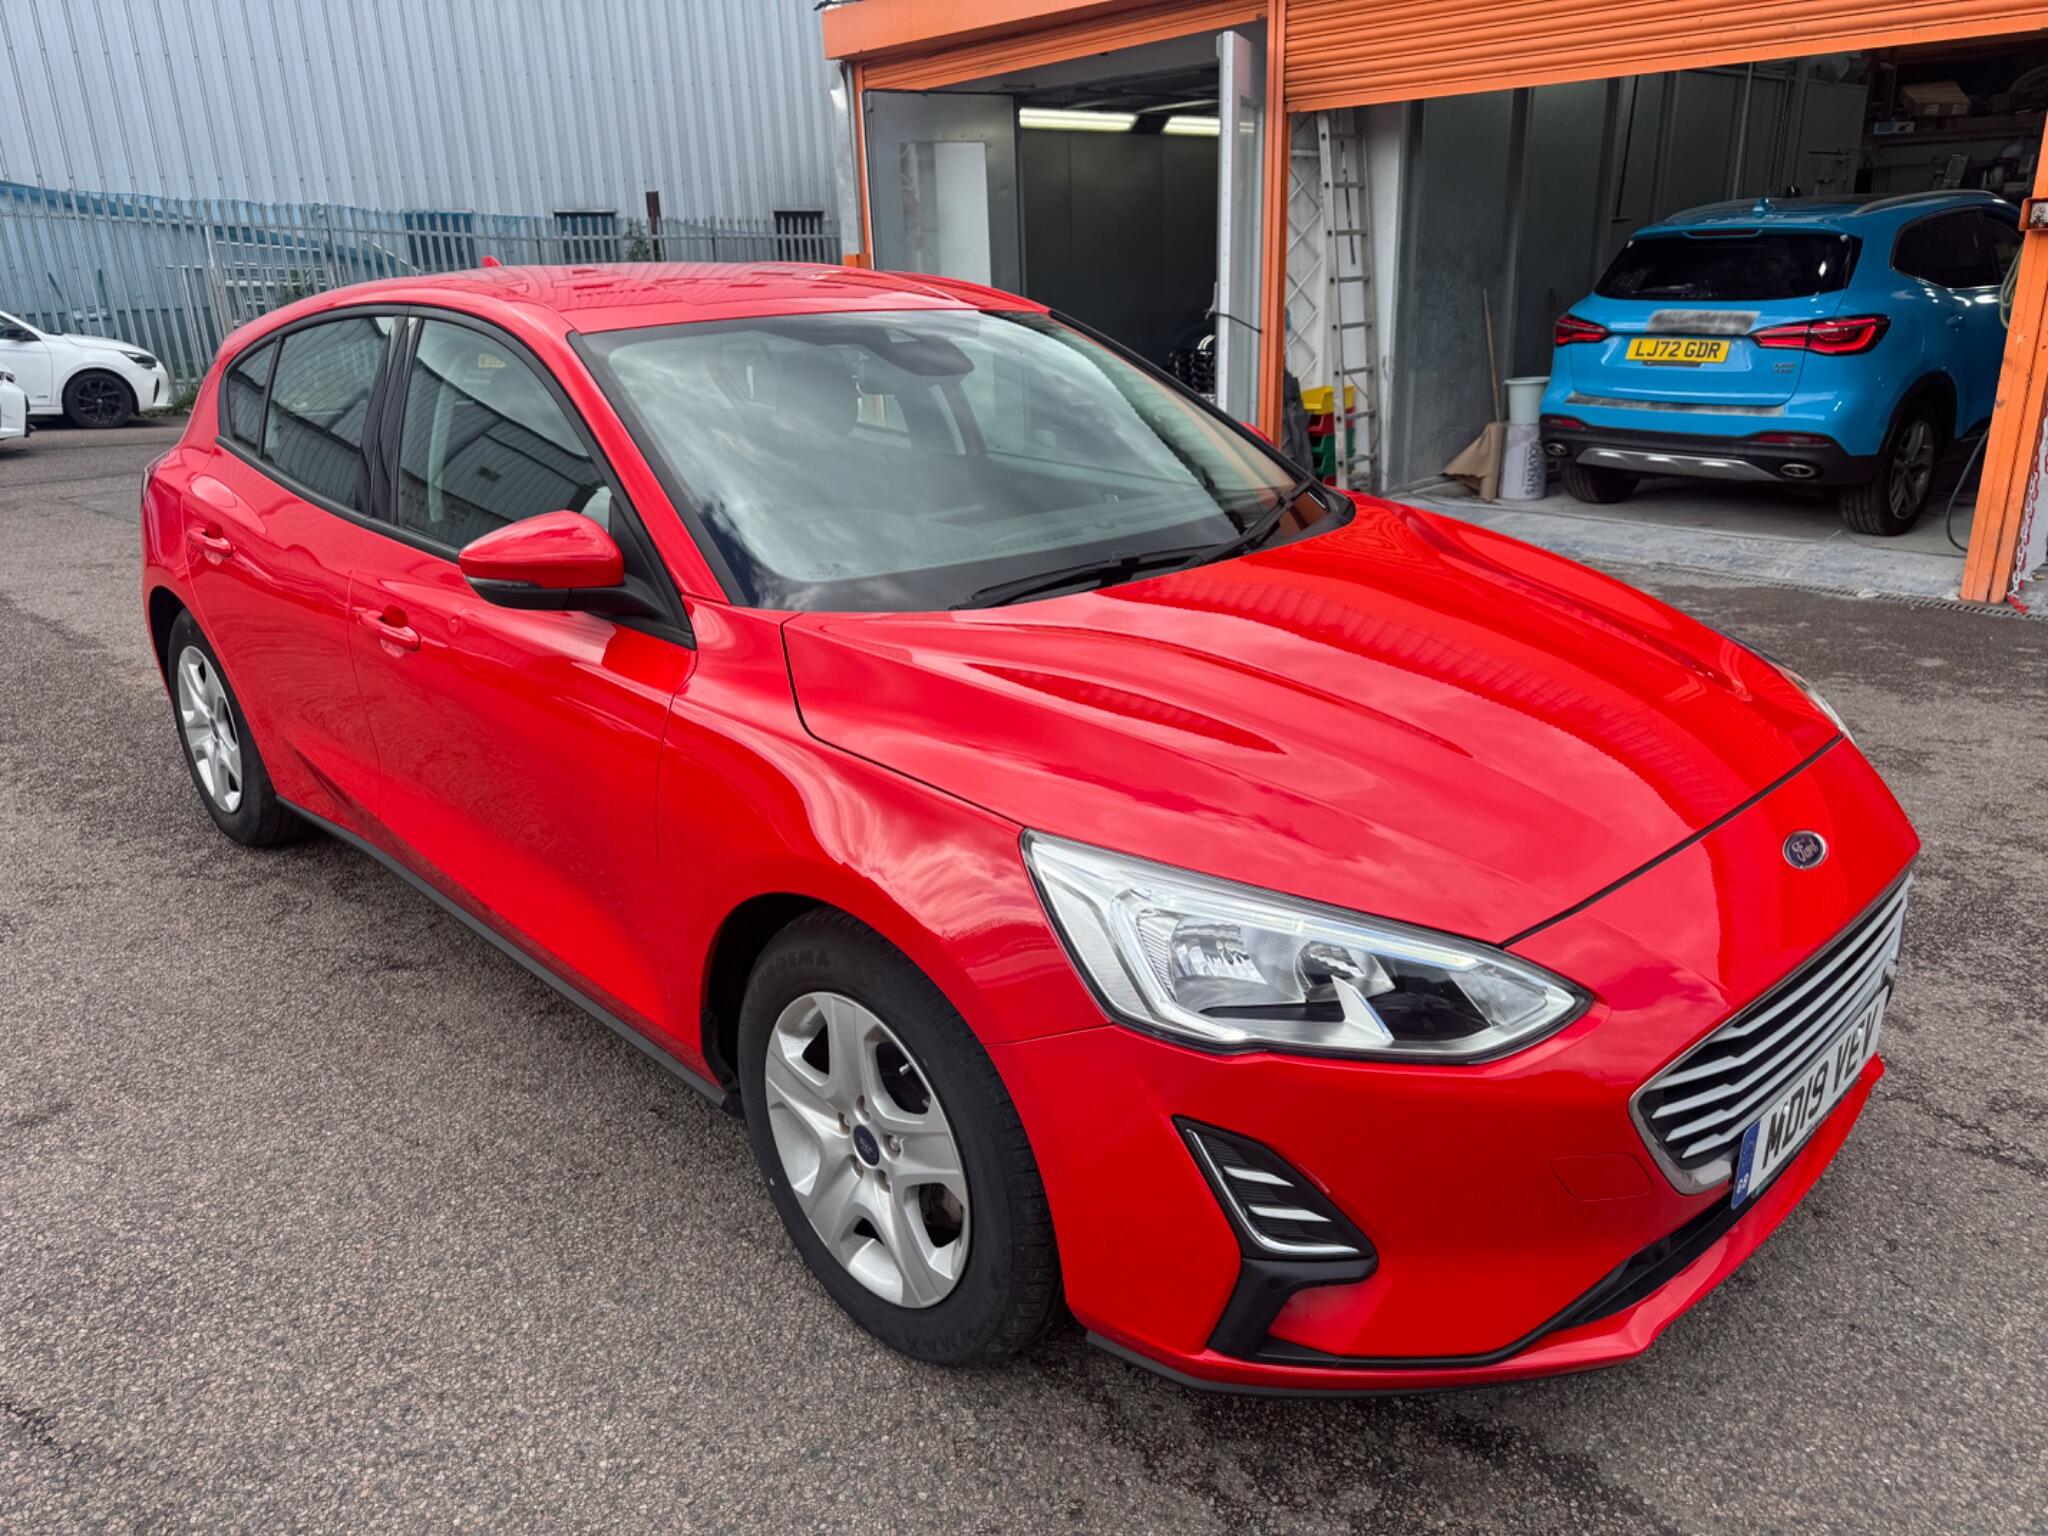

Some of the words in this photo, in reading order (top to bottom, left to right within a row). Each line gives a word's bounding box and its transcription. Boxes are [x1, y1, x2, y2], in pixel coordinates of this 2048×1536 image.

[1635, 341, 1681, 358] LJ72
[1684, 341, 1722, 359] GDR
[1525, 440, 1538, 495] SOLVENTS
[1762, 1060, 1829, 1169] MD19
[1833, 1003, 1879, 1093] VEV
